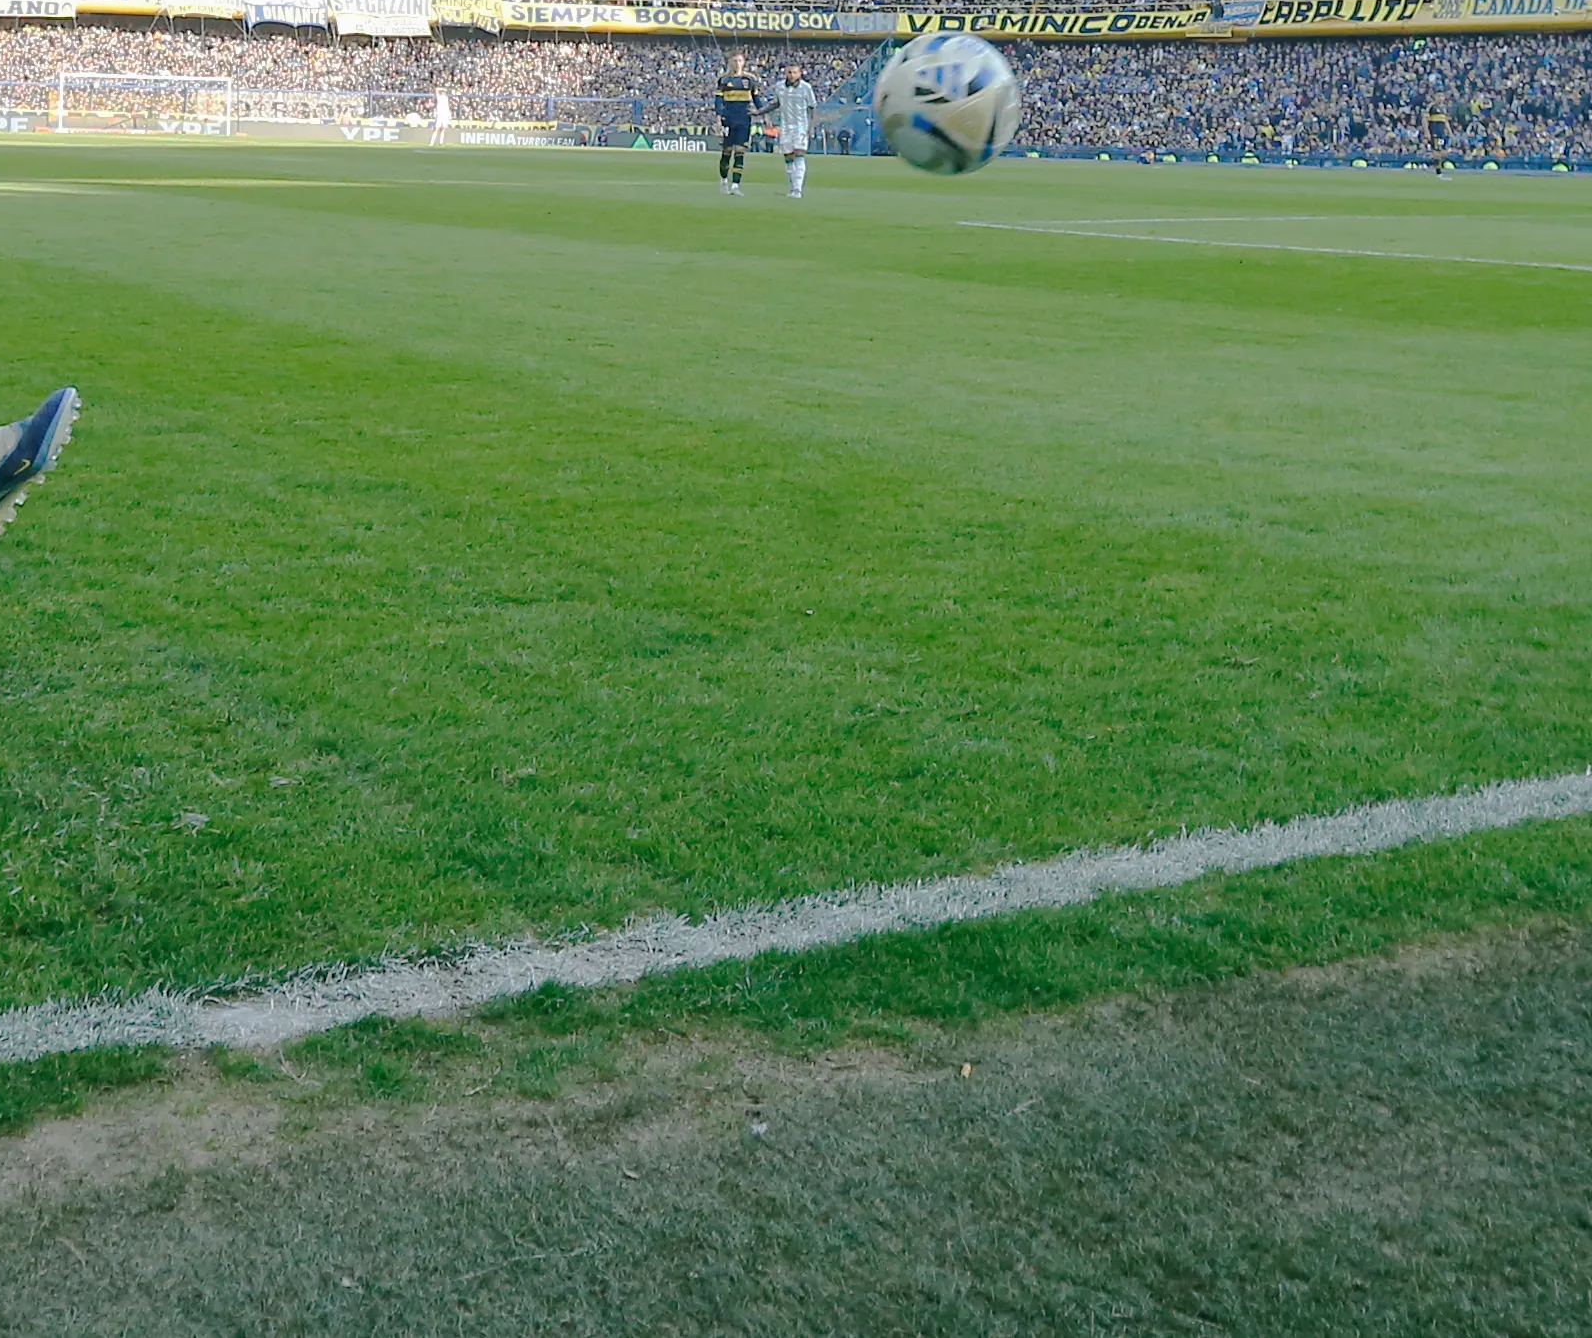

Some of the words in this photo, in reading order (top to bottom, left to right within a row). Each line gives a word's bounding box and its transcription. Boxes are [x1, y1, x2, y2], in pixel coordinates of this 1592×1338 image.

[510, 5, 624, 24] SIEMPRE
[634, 8, 707, 28] BOCA
[710, 11, 794, 30] BOSTERO
[797, 12, 837, 30] SOY
[340, 126, 400, 142] YPF
[460, 132, 516, 145] INFINIA
[652, 135, 707, 153] avalian
